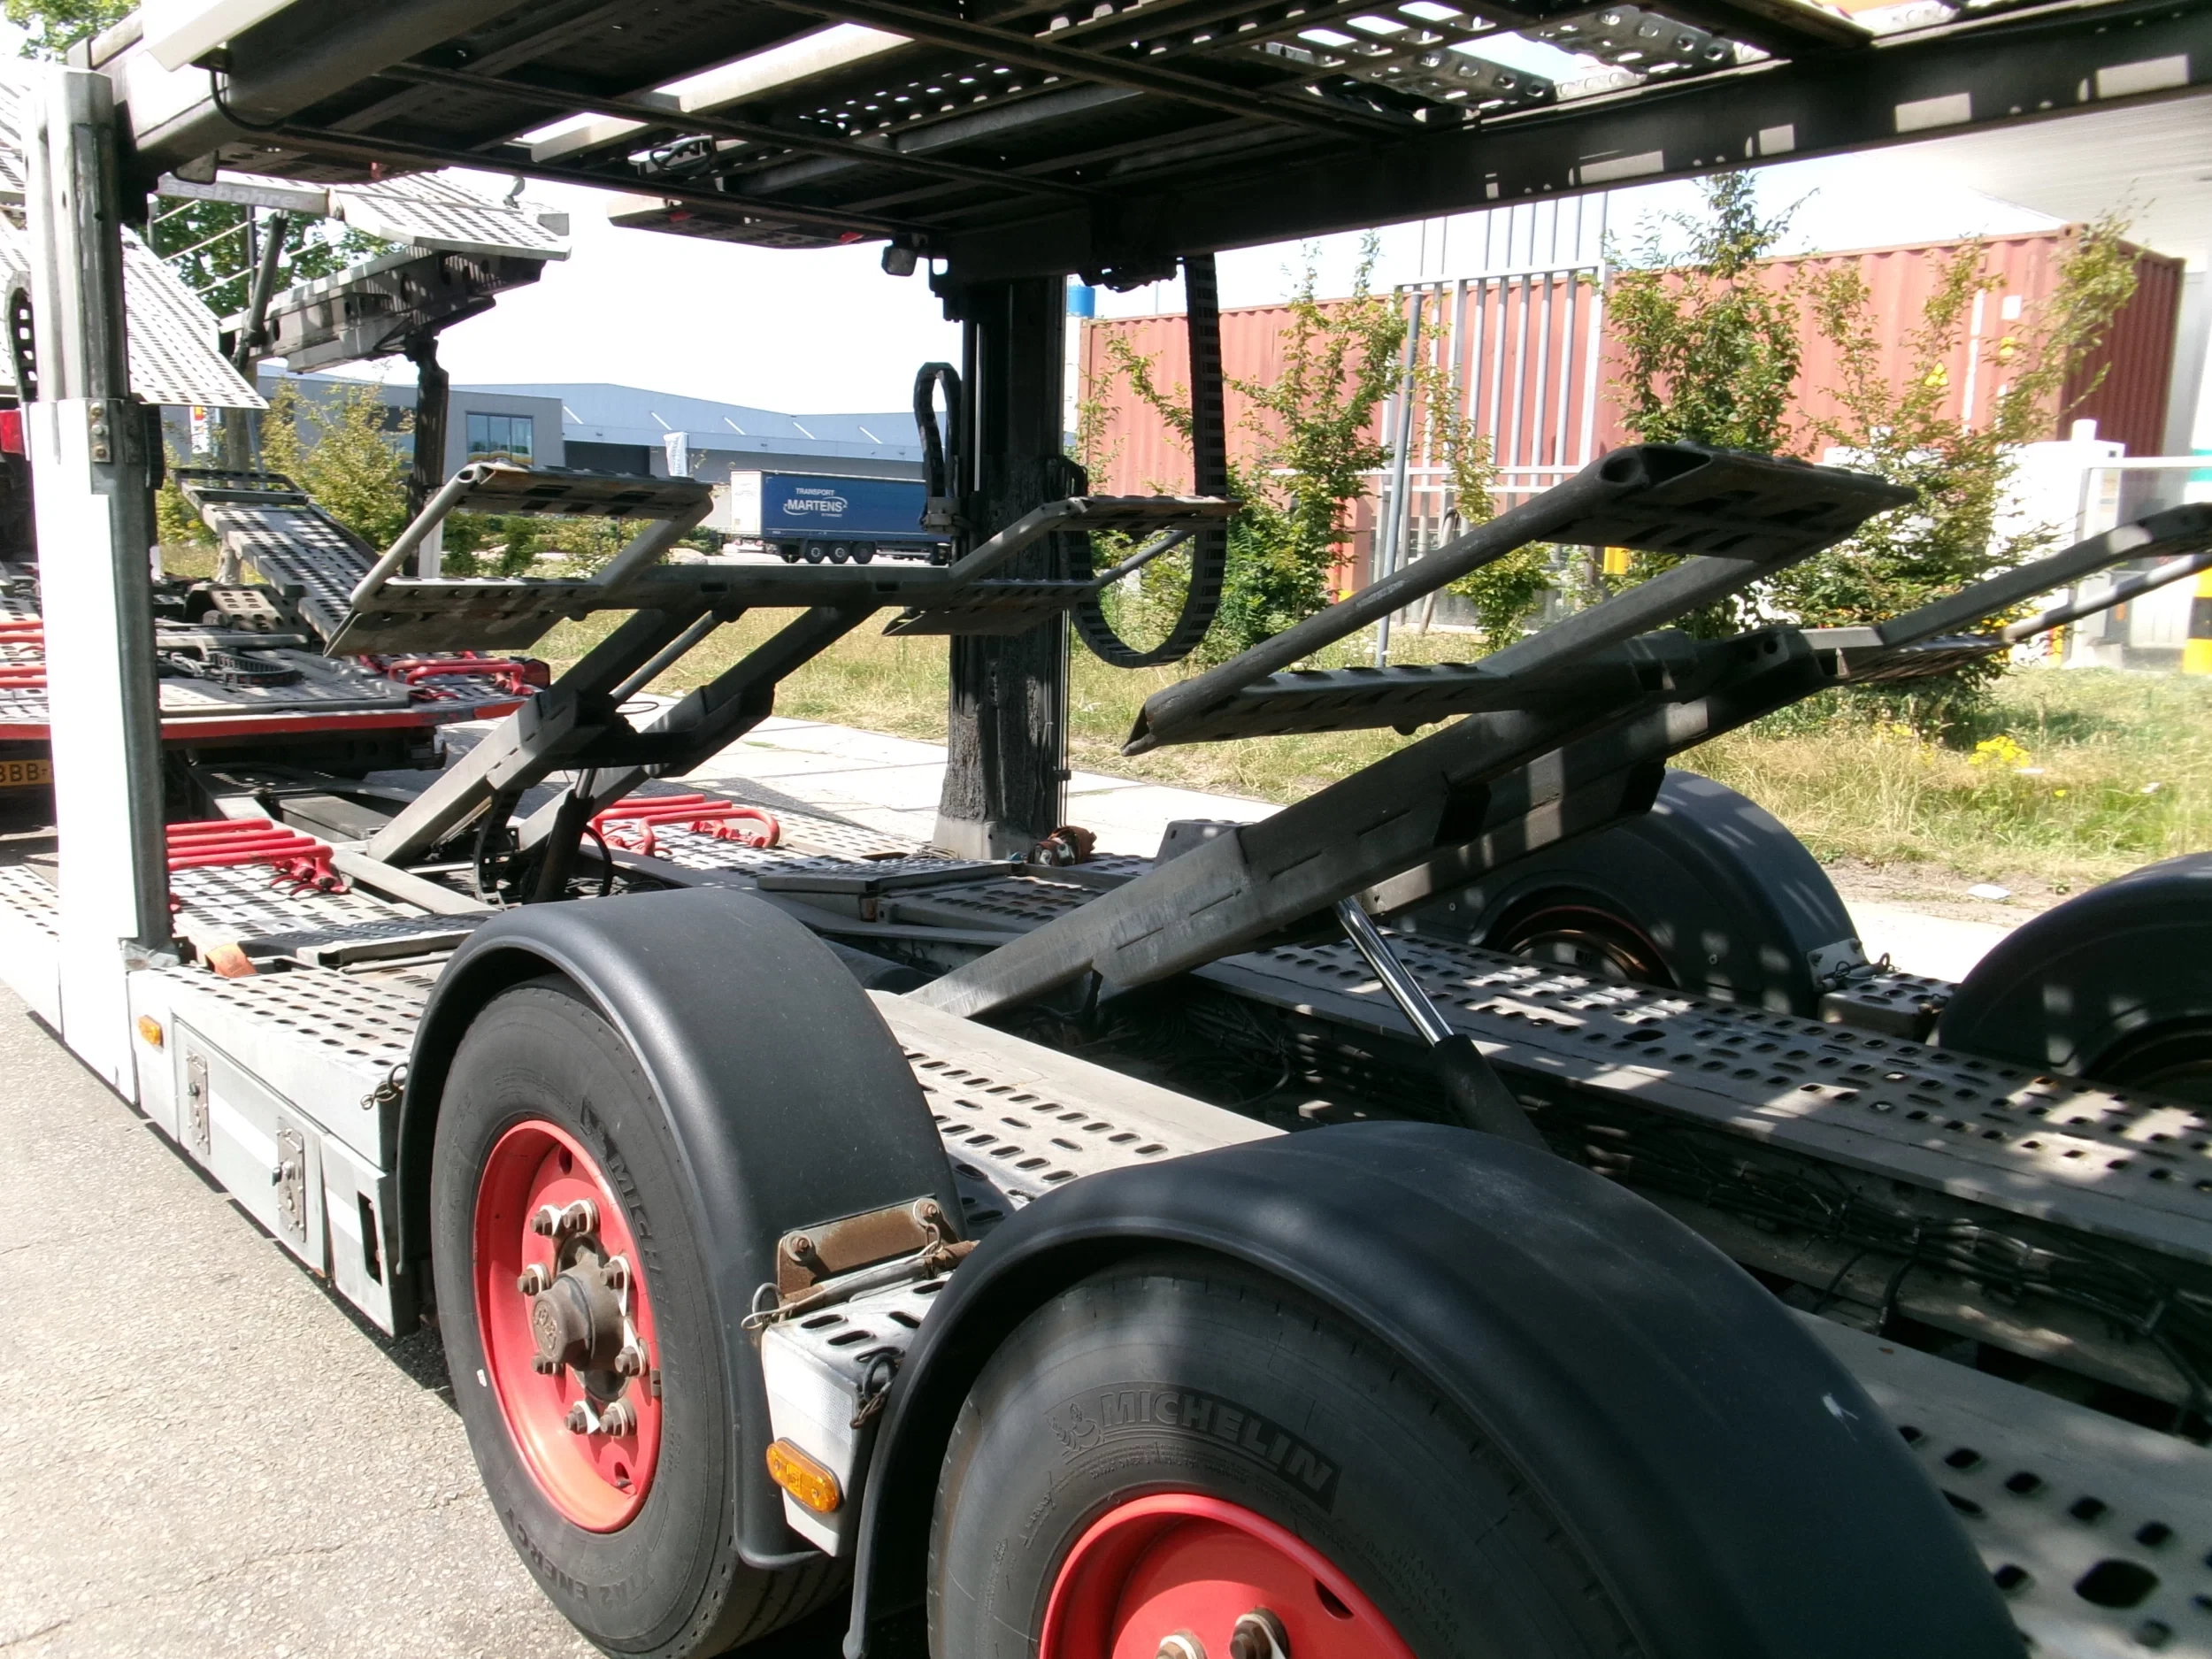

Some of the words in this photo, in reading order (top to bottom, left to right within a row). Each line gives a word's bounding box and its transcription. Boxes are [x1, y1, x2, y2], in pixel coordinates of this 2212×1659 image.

[787, 499, 842, 512] MARTENS
[1101, 1390, 1334, 1491] MICHELIN
[504, 1507, 588, 1601] ENERGY
